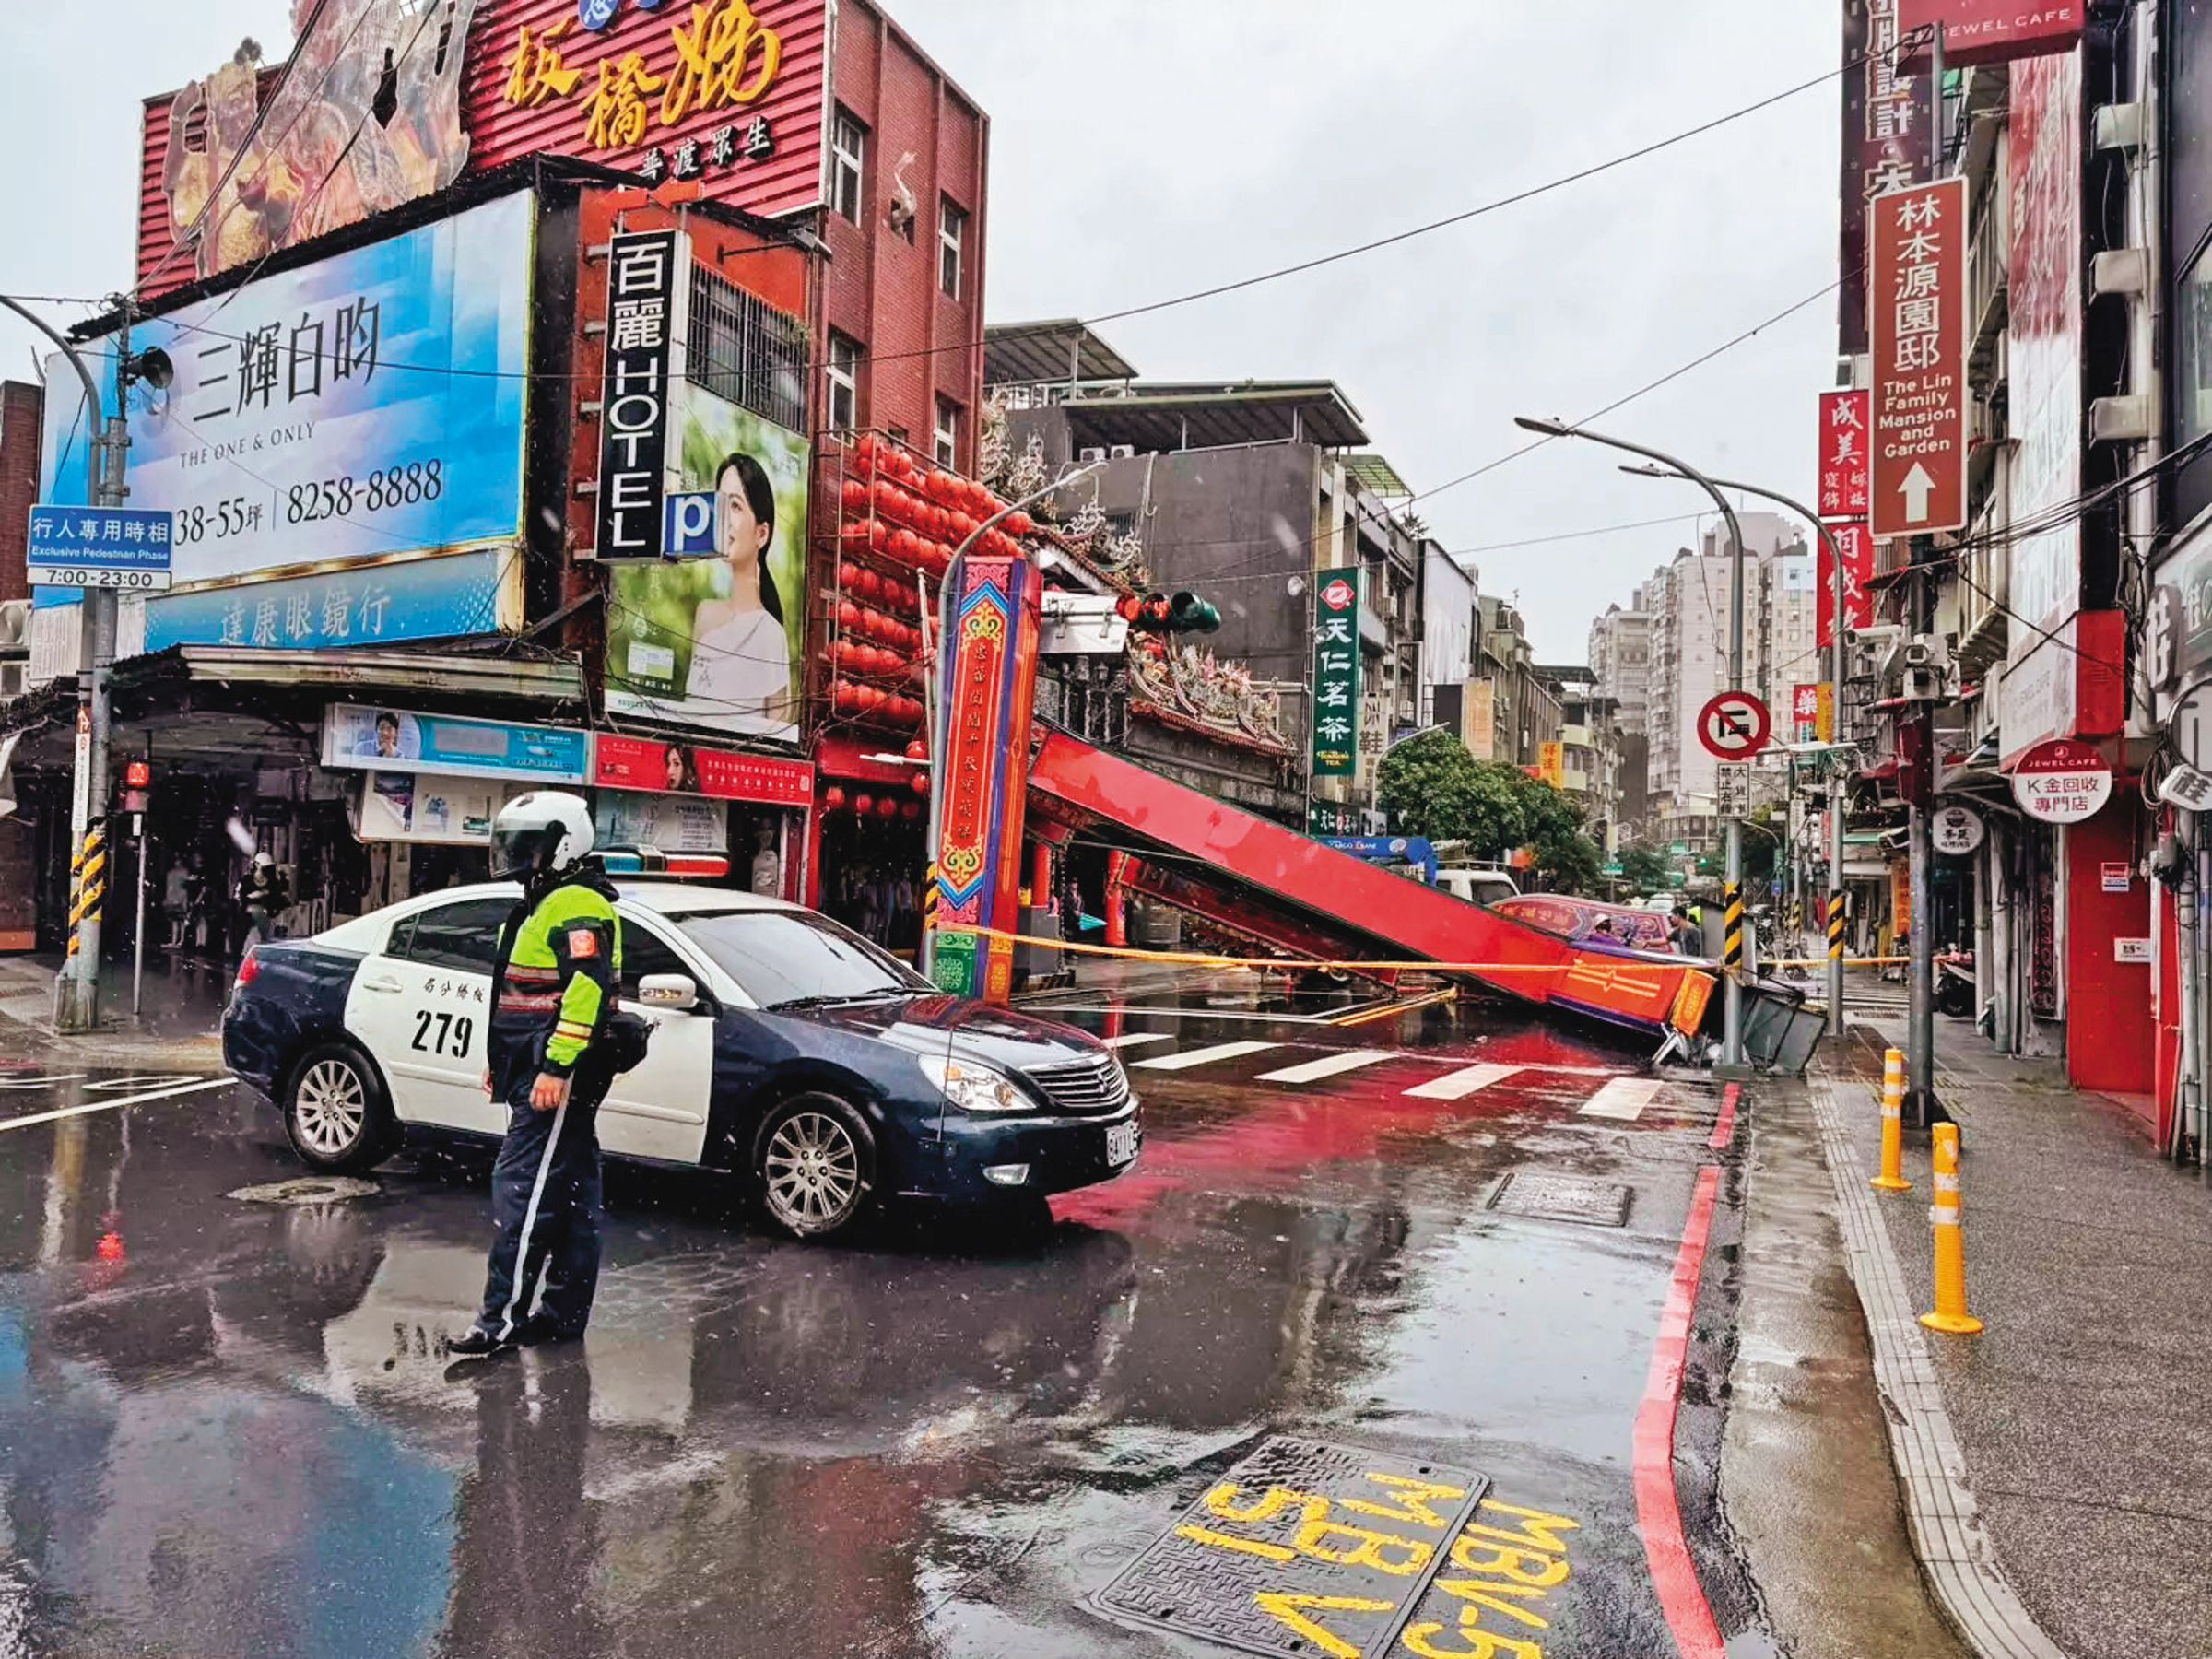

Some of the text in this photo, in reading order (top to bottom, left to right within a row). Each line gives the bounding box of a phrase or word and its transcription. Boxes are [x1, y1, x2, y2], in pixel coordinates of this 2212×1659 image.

[1941, 8, 2072, 38] EWEL CAFE
[611, 241, 668, 351] 百麗
[1894, 194, 1942, 371] 林本源園邸
[194, 296, 380, 421] 三輝白昀
[1884, 374, 1952, 396] The Lin
[1885, 392, 1949, 412] Family
[1830, 396, 1864, 465] 成美
[1879, 408, 1956, 430] Mansion
[1900, 425, 1935, 441] and
[180, 421, 316, 469] THE ONE & ONLY
[609, 357, 659, 547] HOTEL
[1884, 440, 1951, 458] Garden
[287, 458, 442, 524] 8258-8888
[33, 517, 170, 543] 行人專用時相
[31, 545, 81, 557] Exclusive
[135, 550, 169, 560] Phase
[219, 584, 392, 646] 達康眼鏡行
[1316, 618, 1353, 742] 天仁茗茶
[2027, 759, 2098, 768] JEWEL CAFE
[2034, 795, 2089, 812] 專門店
[411, 1009, 473, 1059] 279
